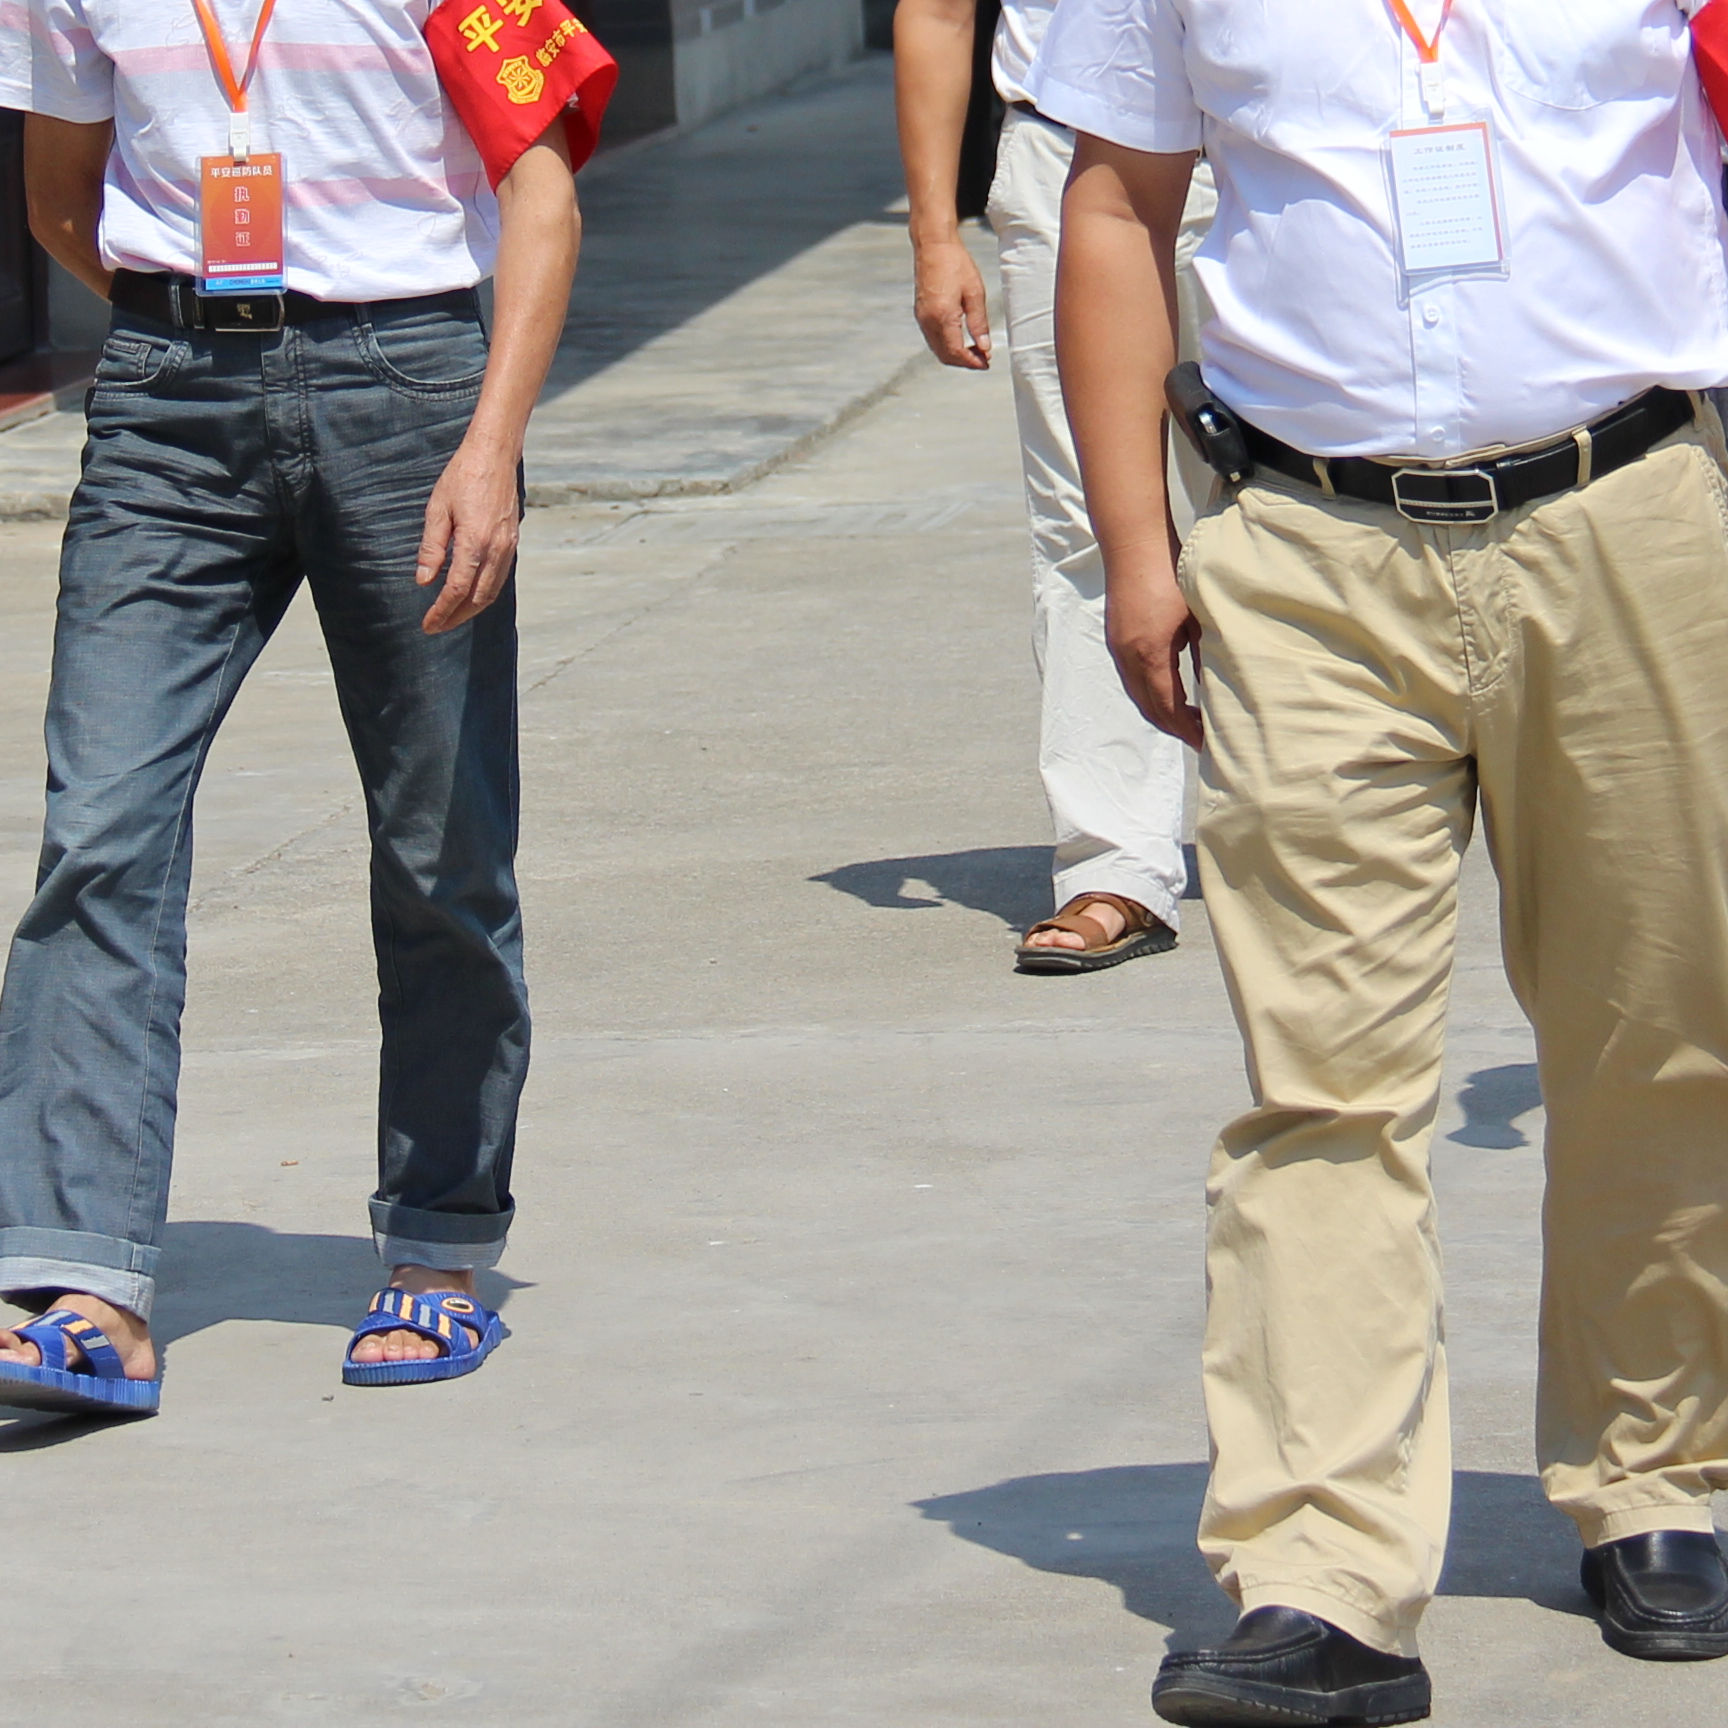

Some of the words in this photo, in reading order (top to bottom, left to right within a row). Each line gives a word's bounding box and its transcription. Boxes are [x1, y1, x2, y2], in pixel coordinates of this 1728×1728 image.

[210, 165, 273, 179] 平安巡防队员
[234, 186, 251, 247] 执勤证
